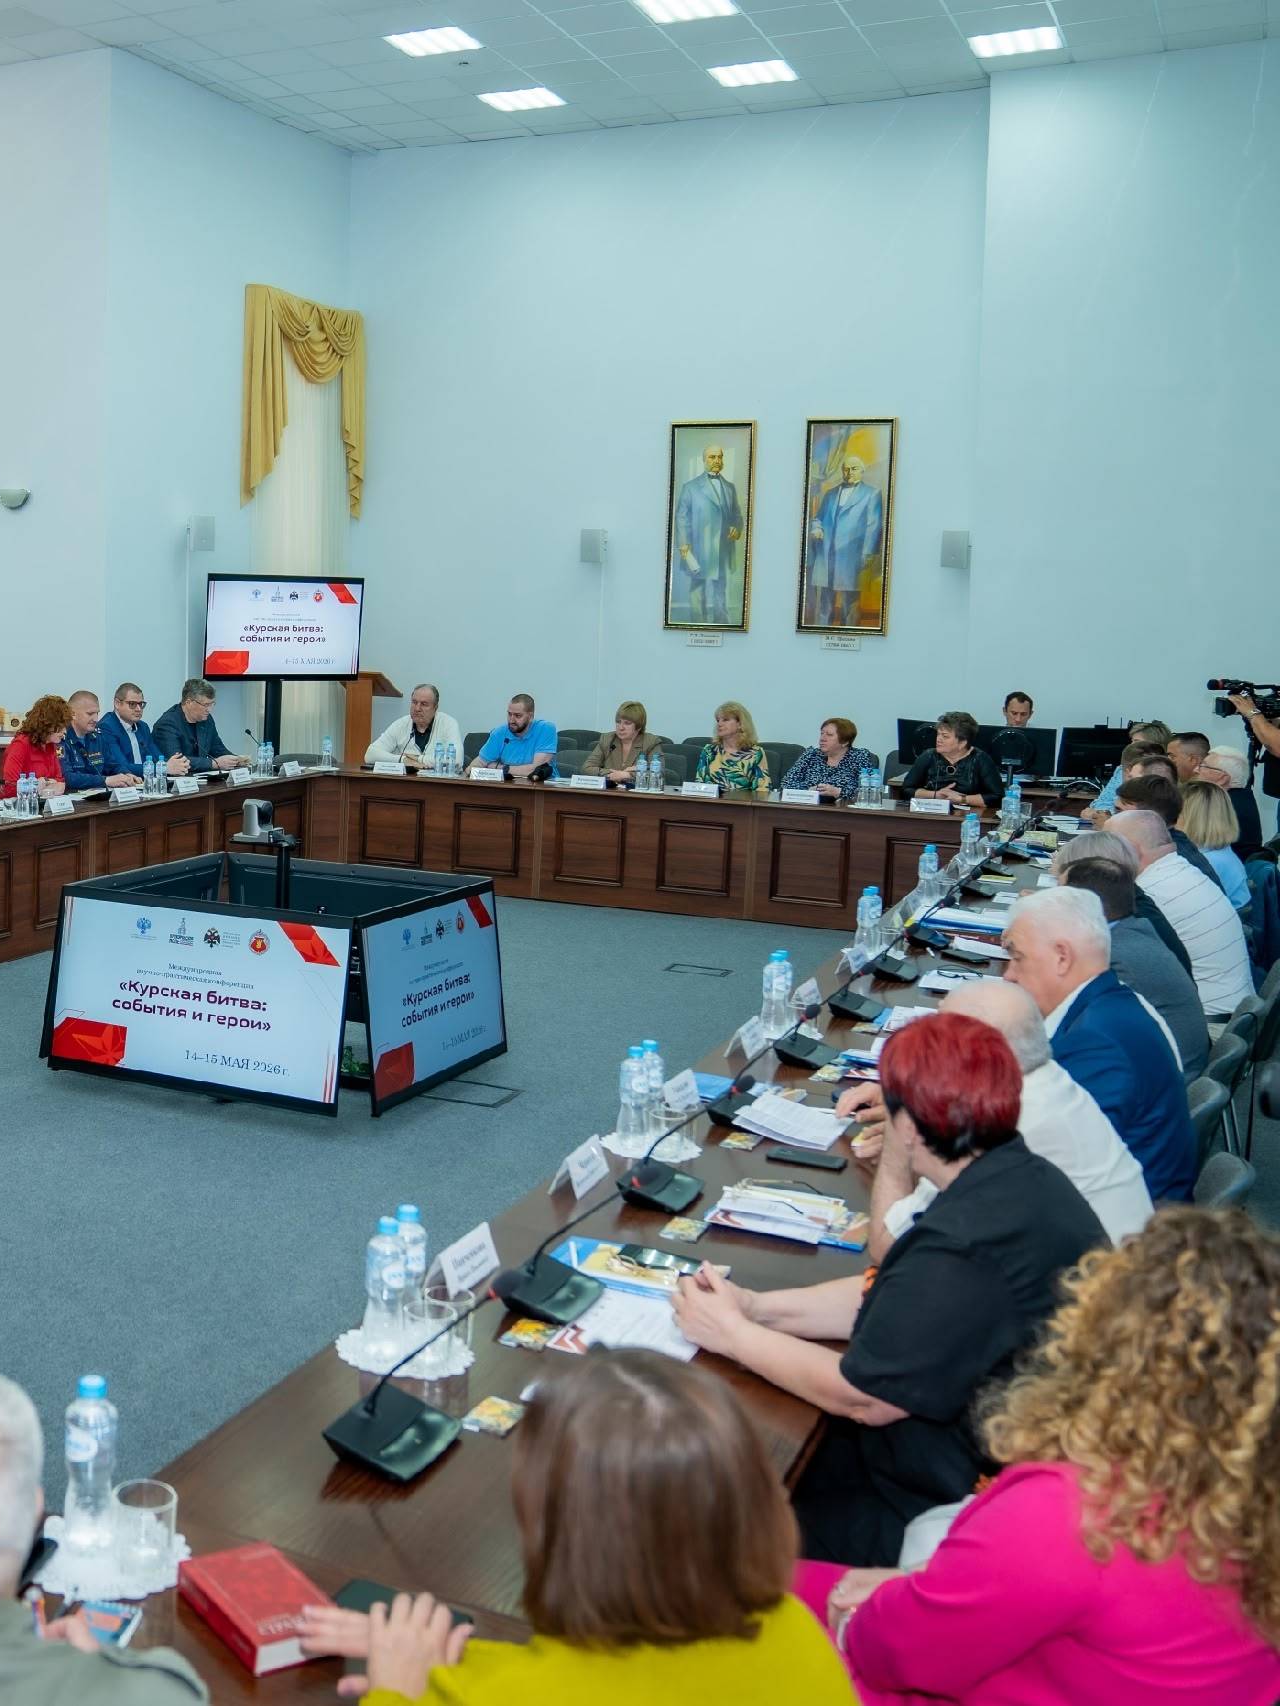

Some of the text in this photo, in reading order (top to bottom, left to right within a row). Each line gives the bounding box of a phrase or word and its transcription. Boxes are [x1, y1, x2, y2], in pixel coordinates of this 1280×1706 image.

[119, 980, 268, 1012] «Курская битва:
[402, 983, 443, 1007] «Курская
[444, 972, 471, 992] битва:
[112, 999, 272, 1032] события и герои»
[401, 991, 475, 1028] события и герои»
[220, 1055, 250, 1070] МАЯ
